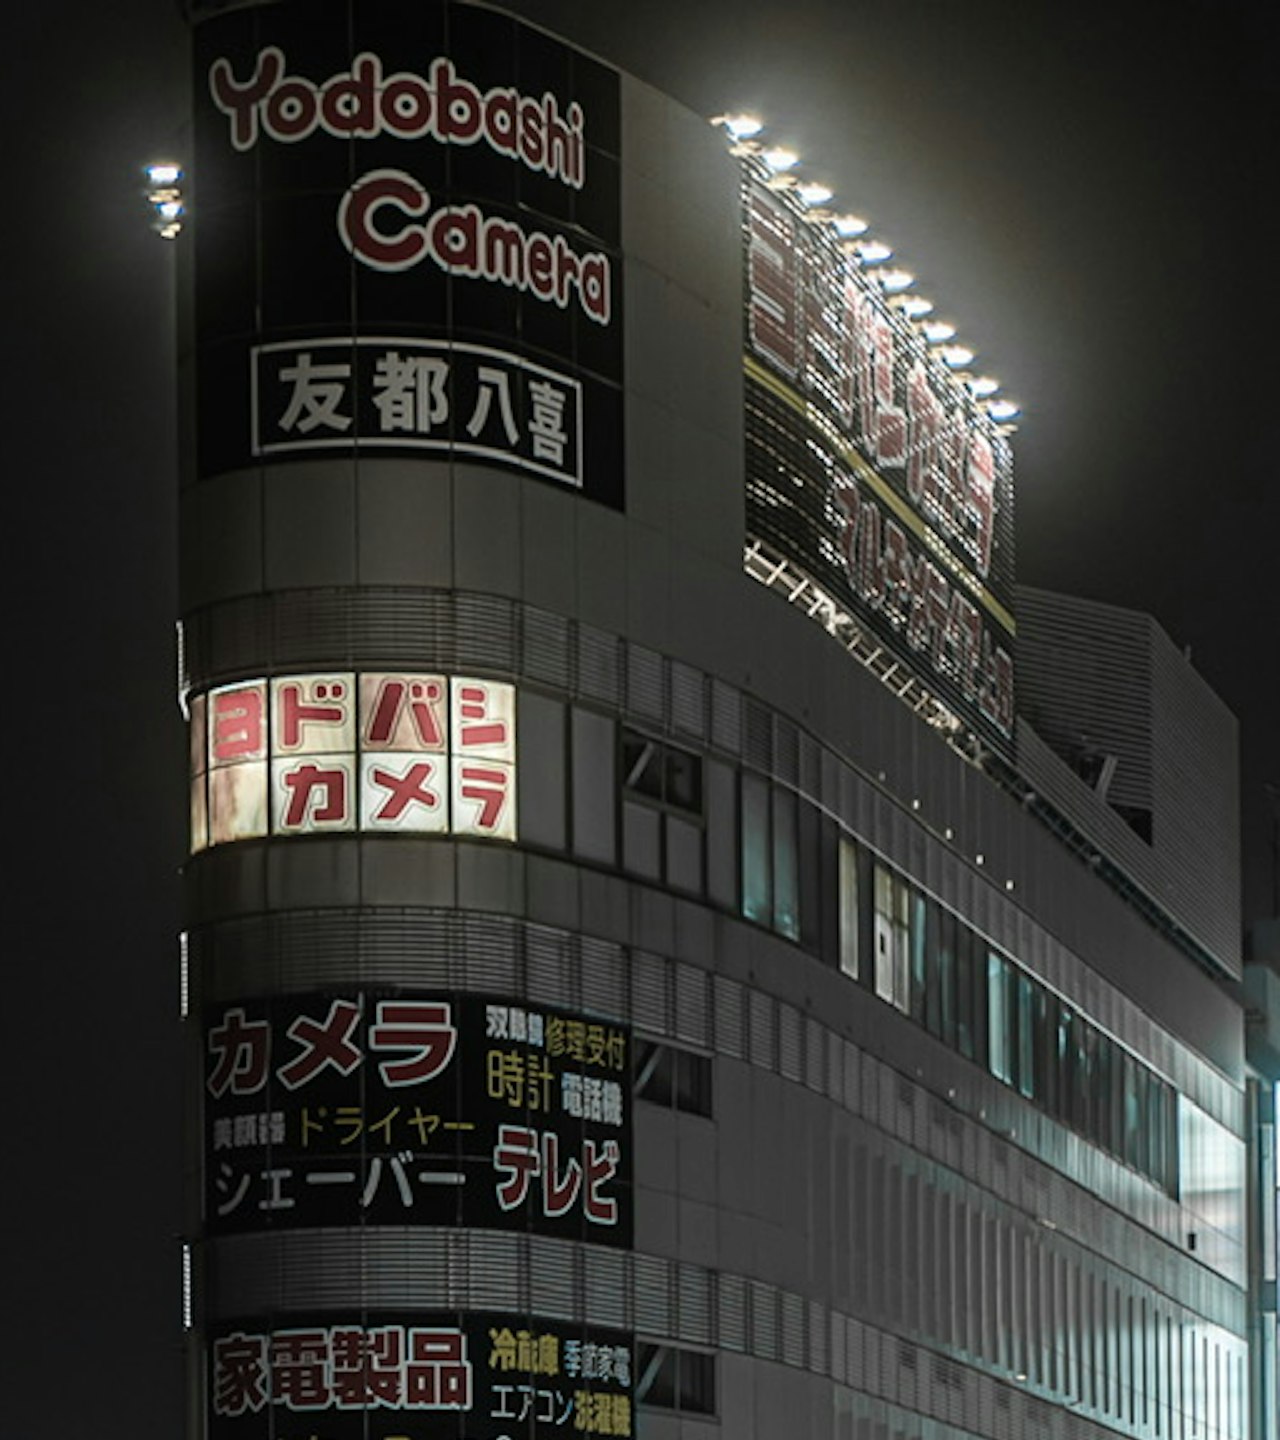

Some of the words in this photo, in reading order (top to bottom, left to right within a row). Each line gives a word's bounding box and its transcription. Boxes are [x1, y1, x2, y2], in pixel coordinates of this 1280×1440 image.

[209, 45, 585, 191] Yodobashi
[338, 168, 611, 326] Camera
[277, 351, 569, 467] 友都八喜
[213, 682, 508, 760] ヨドバシ
[284, 762, 509, 830] カメラ
[207, 998, 458, 1098] カメラ
[487, 1049, 555, 1114] 時計
[300, 1104, 475, 1148] ドライヤー
[216, 1149, 467, 1217] シェーバー
[492, 1124, 620, 1226] テレビ
[212, 1324, 473, 1417] 家電製品
[490, 1384, 573, 1426] エアコン
